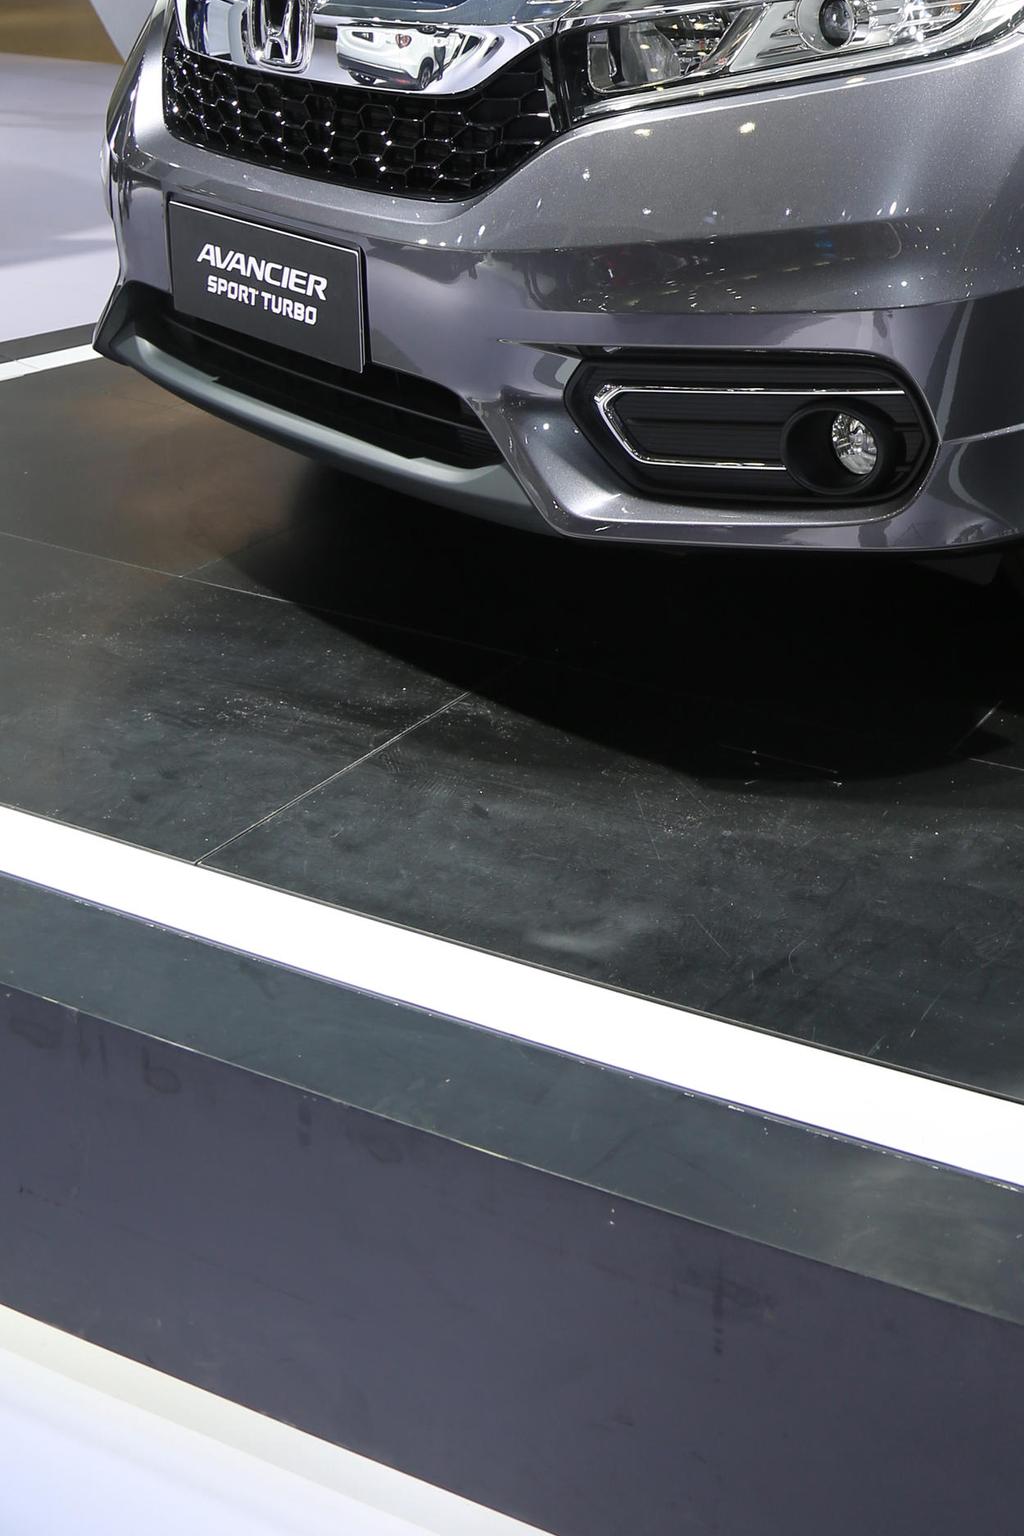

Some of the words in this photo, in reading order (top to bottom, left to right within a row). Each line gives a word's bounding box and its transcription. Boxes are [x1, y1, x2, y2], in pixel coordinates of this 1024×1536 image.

[196, 242, 328, 301] AVANCIER
[207, 274, 260, 307] SPORT
[260, 290, 318, 326] TURBO
